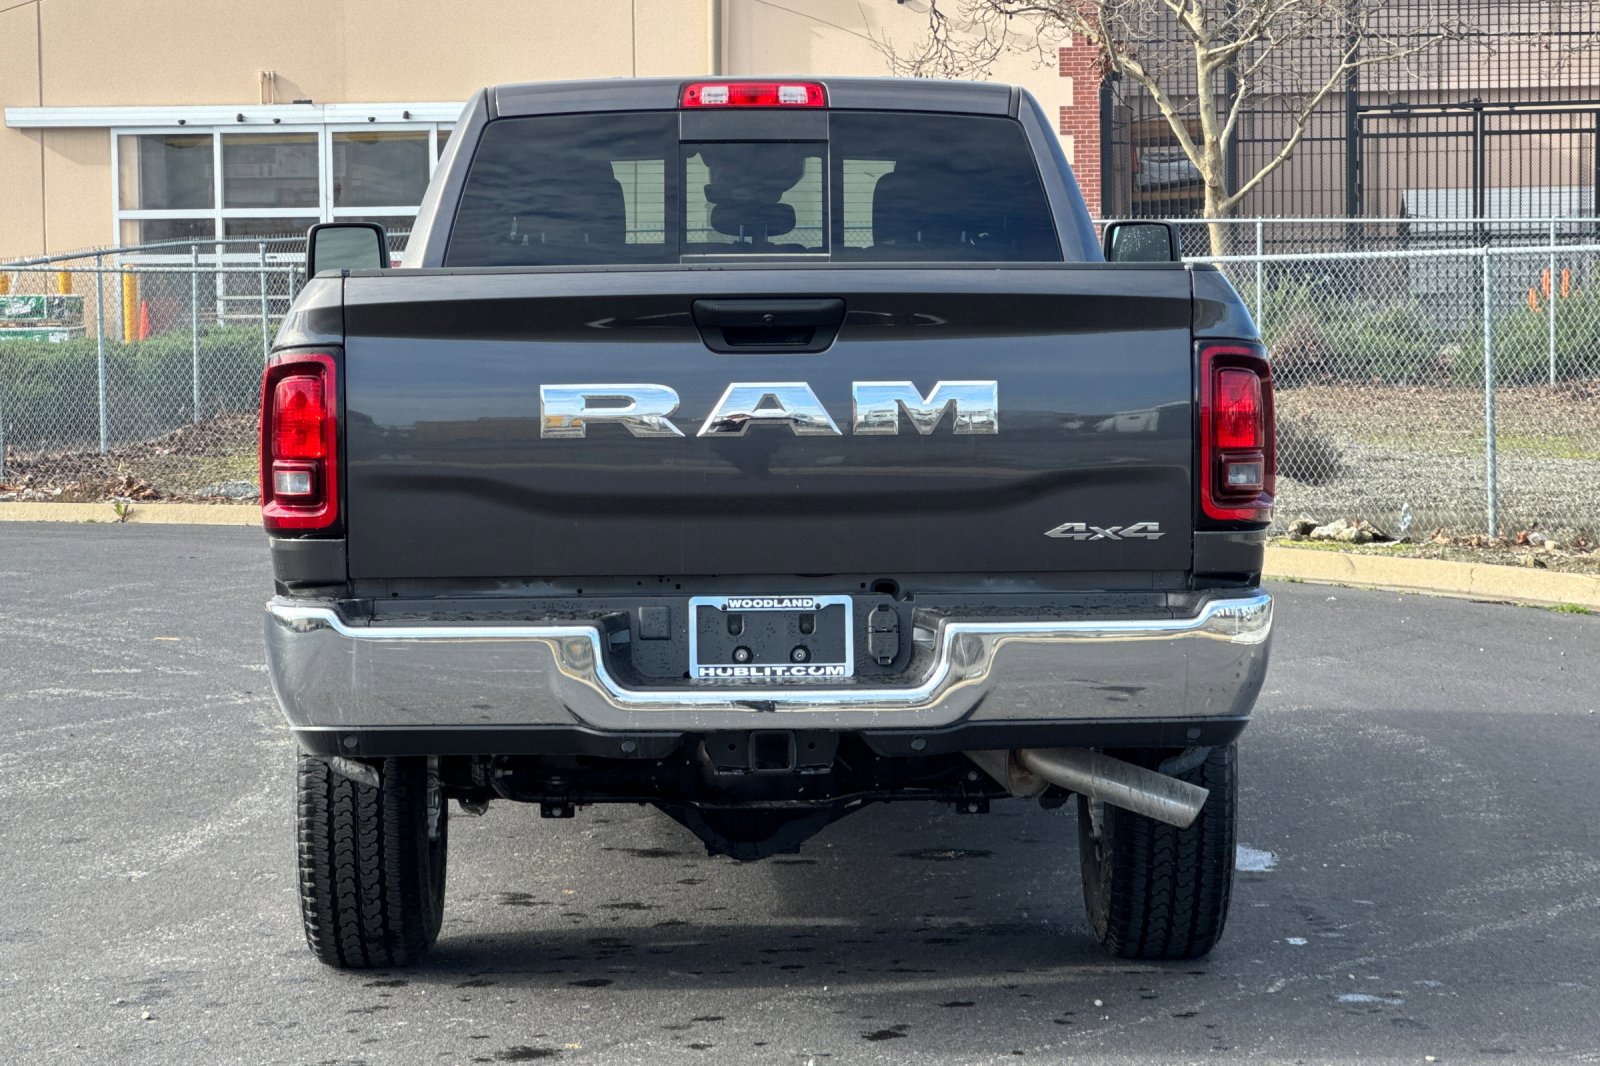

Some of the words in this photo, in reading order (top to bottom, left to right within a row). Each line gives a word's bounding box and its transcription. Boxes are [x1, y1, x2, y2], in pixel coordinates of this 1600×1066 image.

[539, 380, 999, 438] RAM
[1043, 522, 1167, 541] 4x4
[728, 598, 813, 608] WOODLAND
